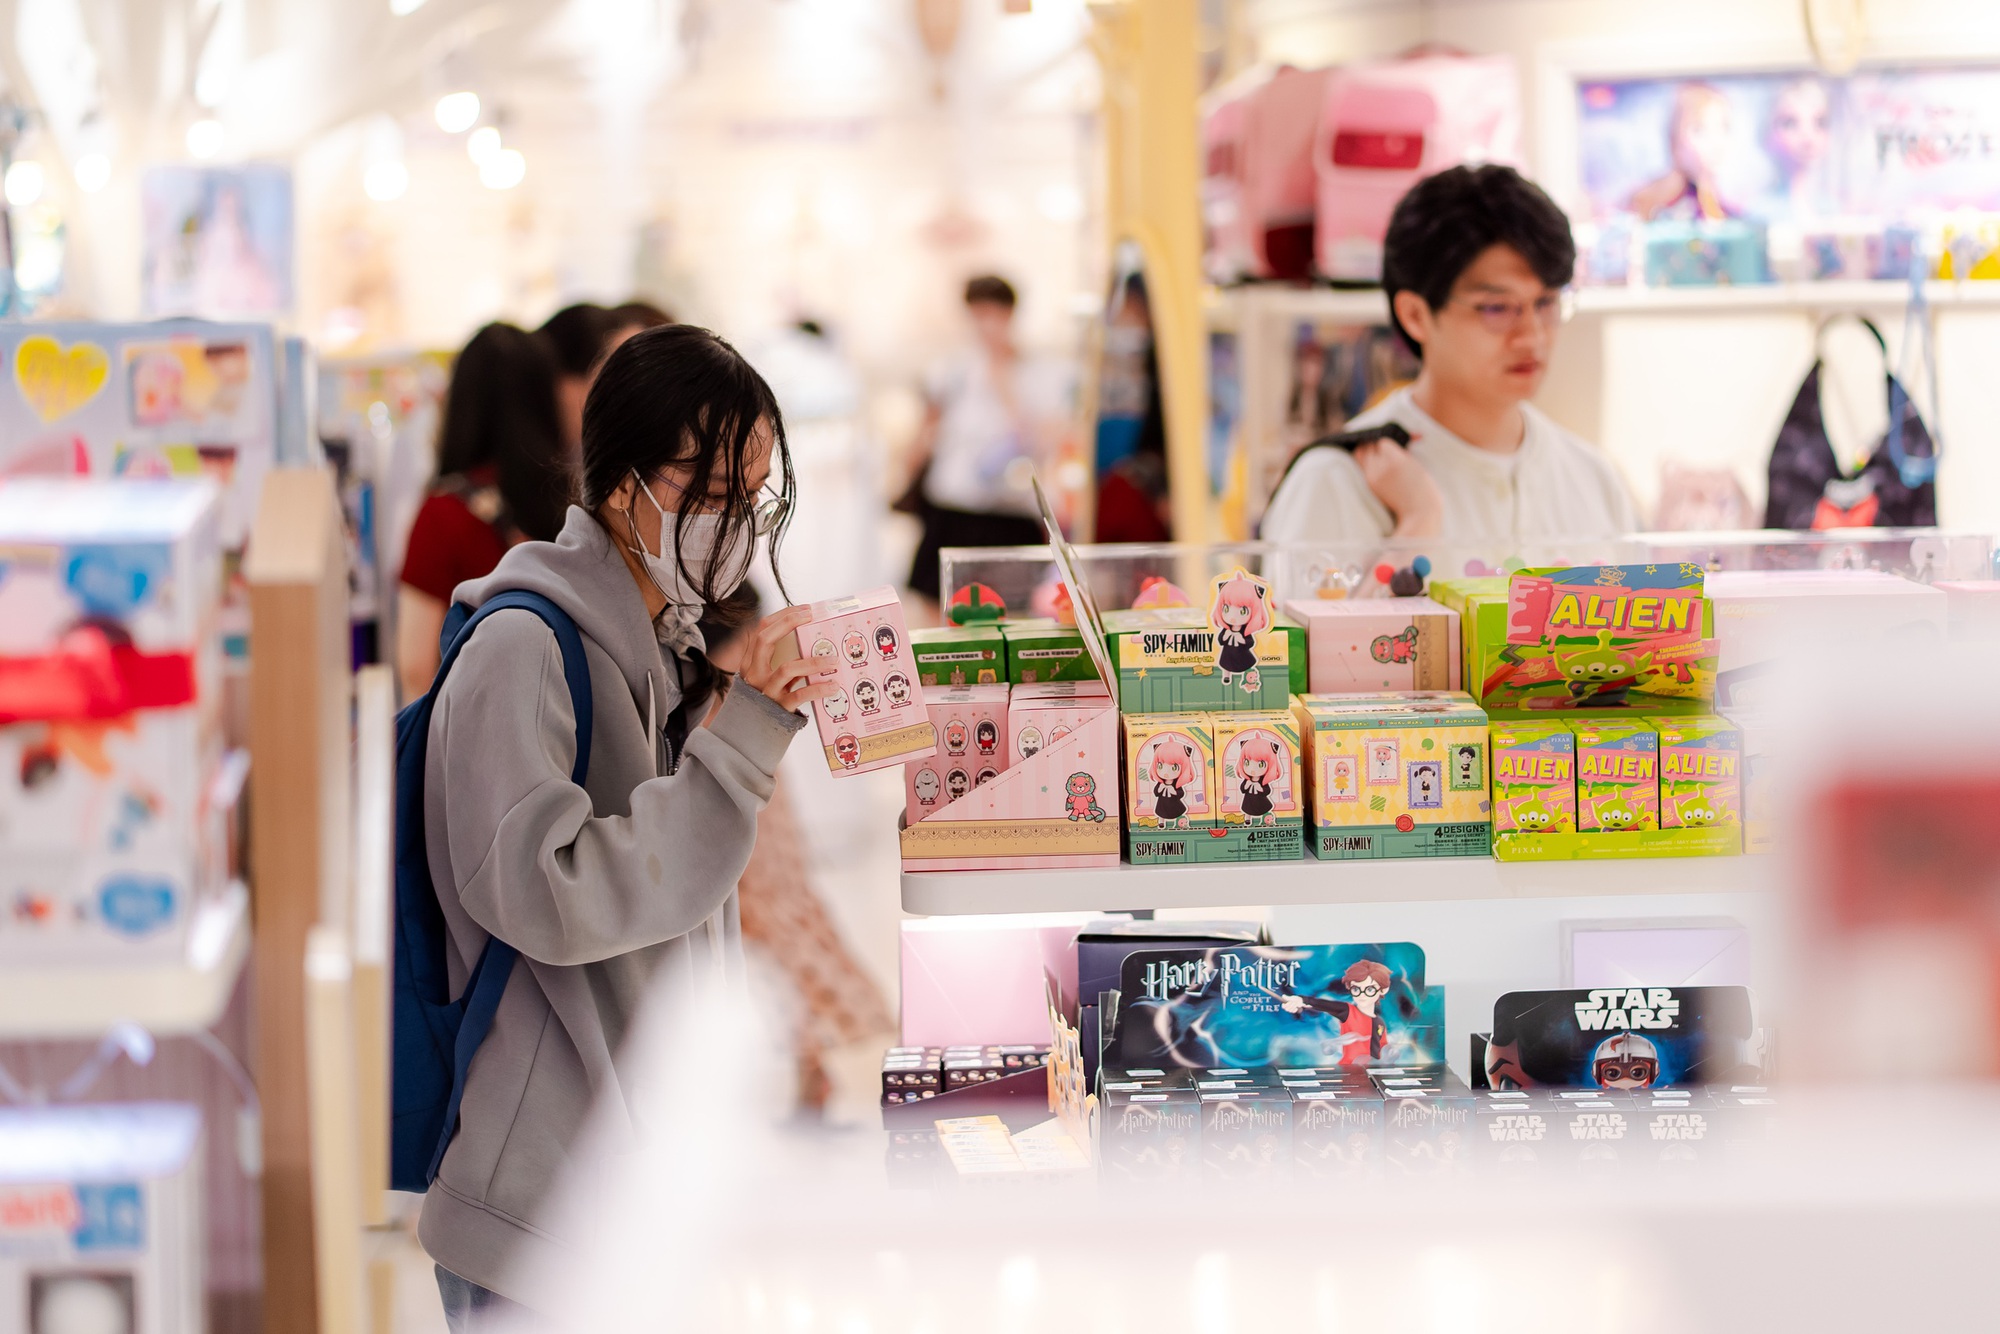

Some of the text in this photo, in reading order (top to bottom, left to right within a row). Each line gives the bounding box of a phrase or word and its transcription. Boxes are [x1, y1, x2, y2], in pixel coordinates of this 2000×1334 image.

[1550, 594, 1693, 631] ALIEN
[1499, 756, 1572, 779] ALIEN
[1582, 754, 1655, 779] ALIEN
[1665, 753, 1736, 777] ALIEN
[1247, 829, 1298, 843] 4 DESIGNS
[1434, 825, 1485, 838] 4 DESIGNS
[1140, 953, 1301, 1010] Harry Potter
[1230, 996, 1271, 1004] GOBLET
[1252, 1003, 1280, 1012] FIRE
[1574, 988, 1679, 1010] STAR
[1574, 1008, 1679, 1031] WARS
[1156, 1109, 1194, 1133] Potter
[1248, 1107, 1285, 1129] Potter
[1340, 1105, 1377, 1128] Potter
[1431, 1104, 1468, 1126] Potter
[1489, 1115, 1546, 1128] STAR
[1569, 1114, 1627, 1127] STAR
[1649, 1114, 1707, 1127] STAR
[1489, 1127, 1546, 1141] WARS
[1569, 1126, 1627, 1140] WARS
[1649, 1126, 1707, 1140] WARS
